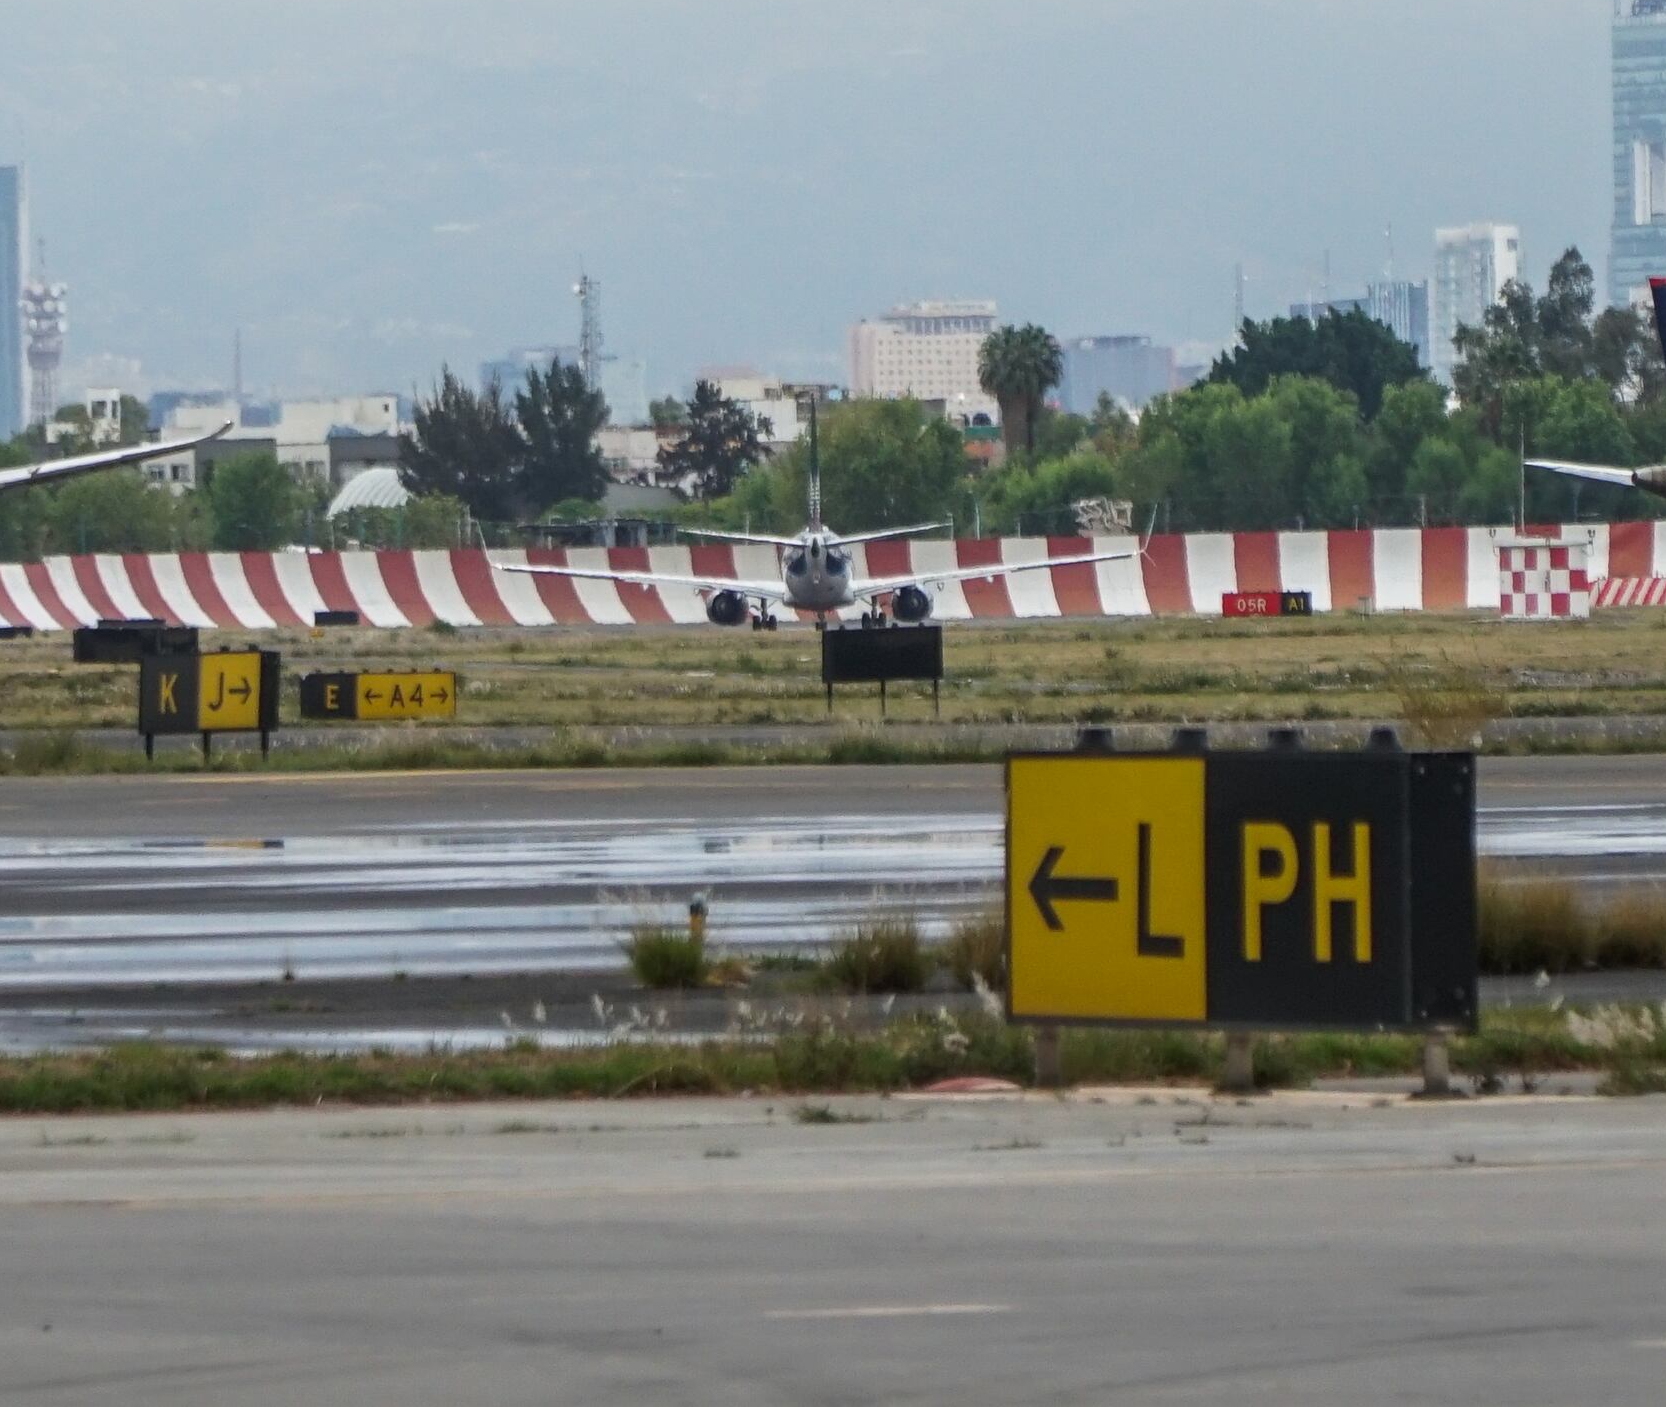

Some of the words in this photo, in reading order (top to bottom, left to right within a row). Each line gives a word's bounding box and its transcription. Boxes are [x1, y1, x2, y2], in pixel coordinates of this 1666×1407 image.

[1237, 598, 1267, 612] 05R
[1288, 597, 1304, 611] A1
[159, 674, 178, 714] K
[208, 672, 225, 712] J
[325, 685, 340, 710] E
[389, 684, 425, 709] A4
[1137, 822, 1185, 958] L
[1244, 822, 1372, 963] PH
